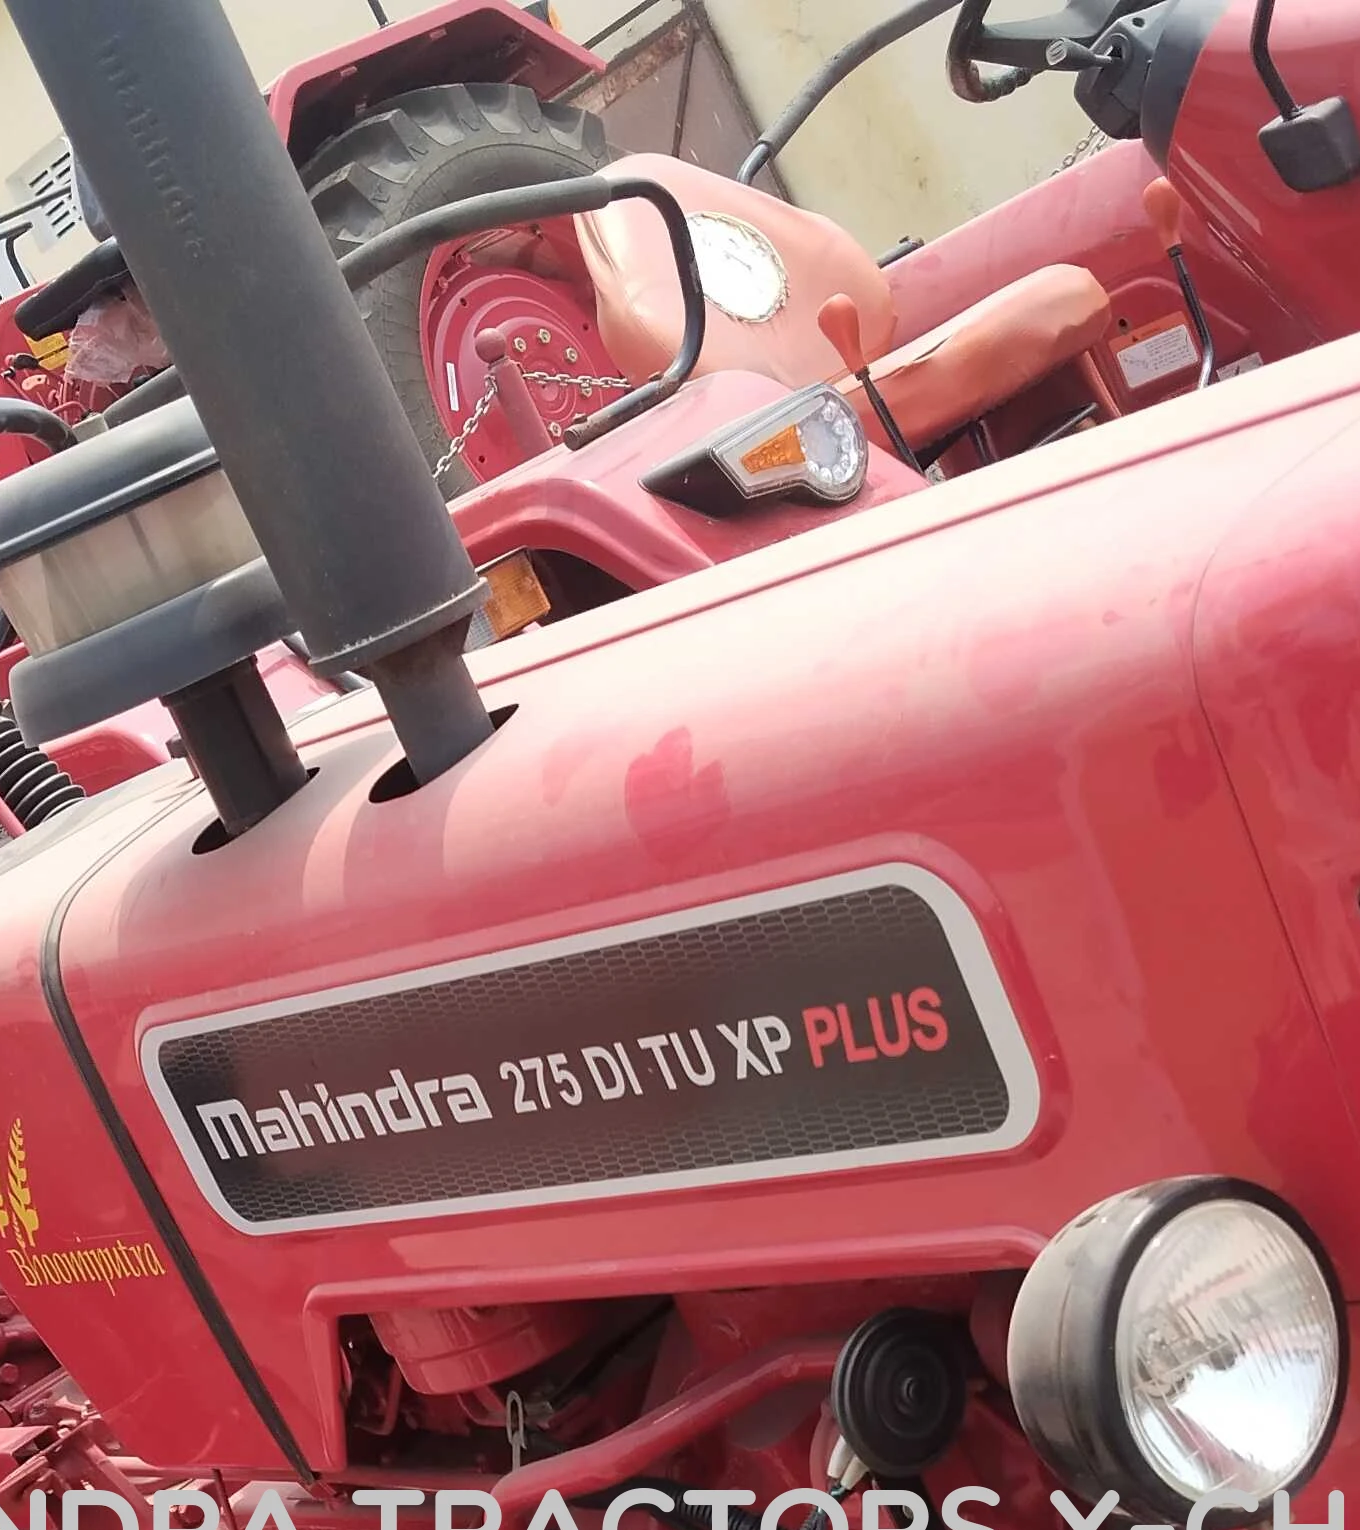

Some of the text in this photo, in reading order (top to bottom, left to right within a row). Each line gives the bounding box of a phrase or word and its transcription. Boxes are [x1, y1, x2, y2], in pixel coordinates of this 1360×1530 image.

[196, 986, 950, 1160] Mahindra 275 DI TU XP PLUS
